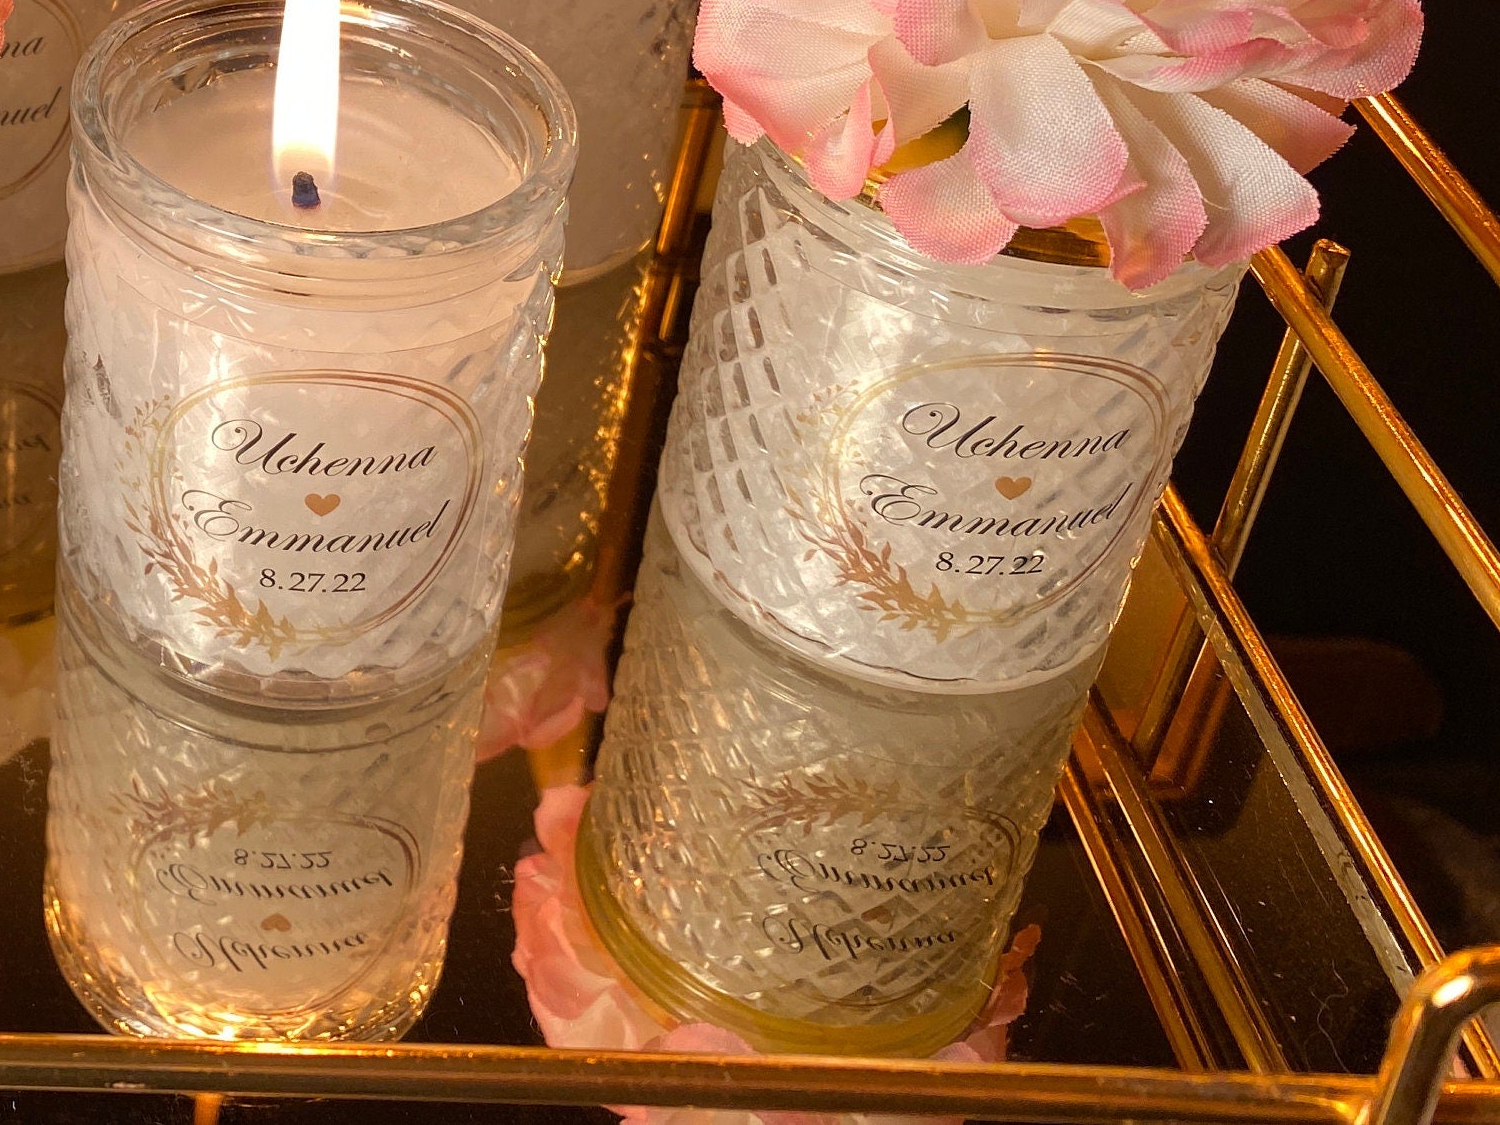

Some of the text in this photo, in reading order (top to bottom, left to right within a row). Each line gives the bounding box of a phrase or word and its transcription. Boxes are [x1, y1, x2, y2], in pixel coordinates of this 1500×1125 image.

[211, 419, 438, 476] Uchenna
[902, 402, 1132, 460] Uchenna
[181, 489, 451, 553] Emmanuel
[859, 474, 1133, 537] Emmanuel
[259, 568, 366, 593] 8.27.22
[935, 551, 1045, 576] 8.27.22
